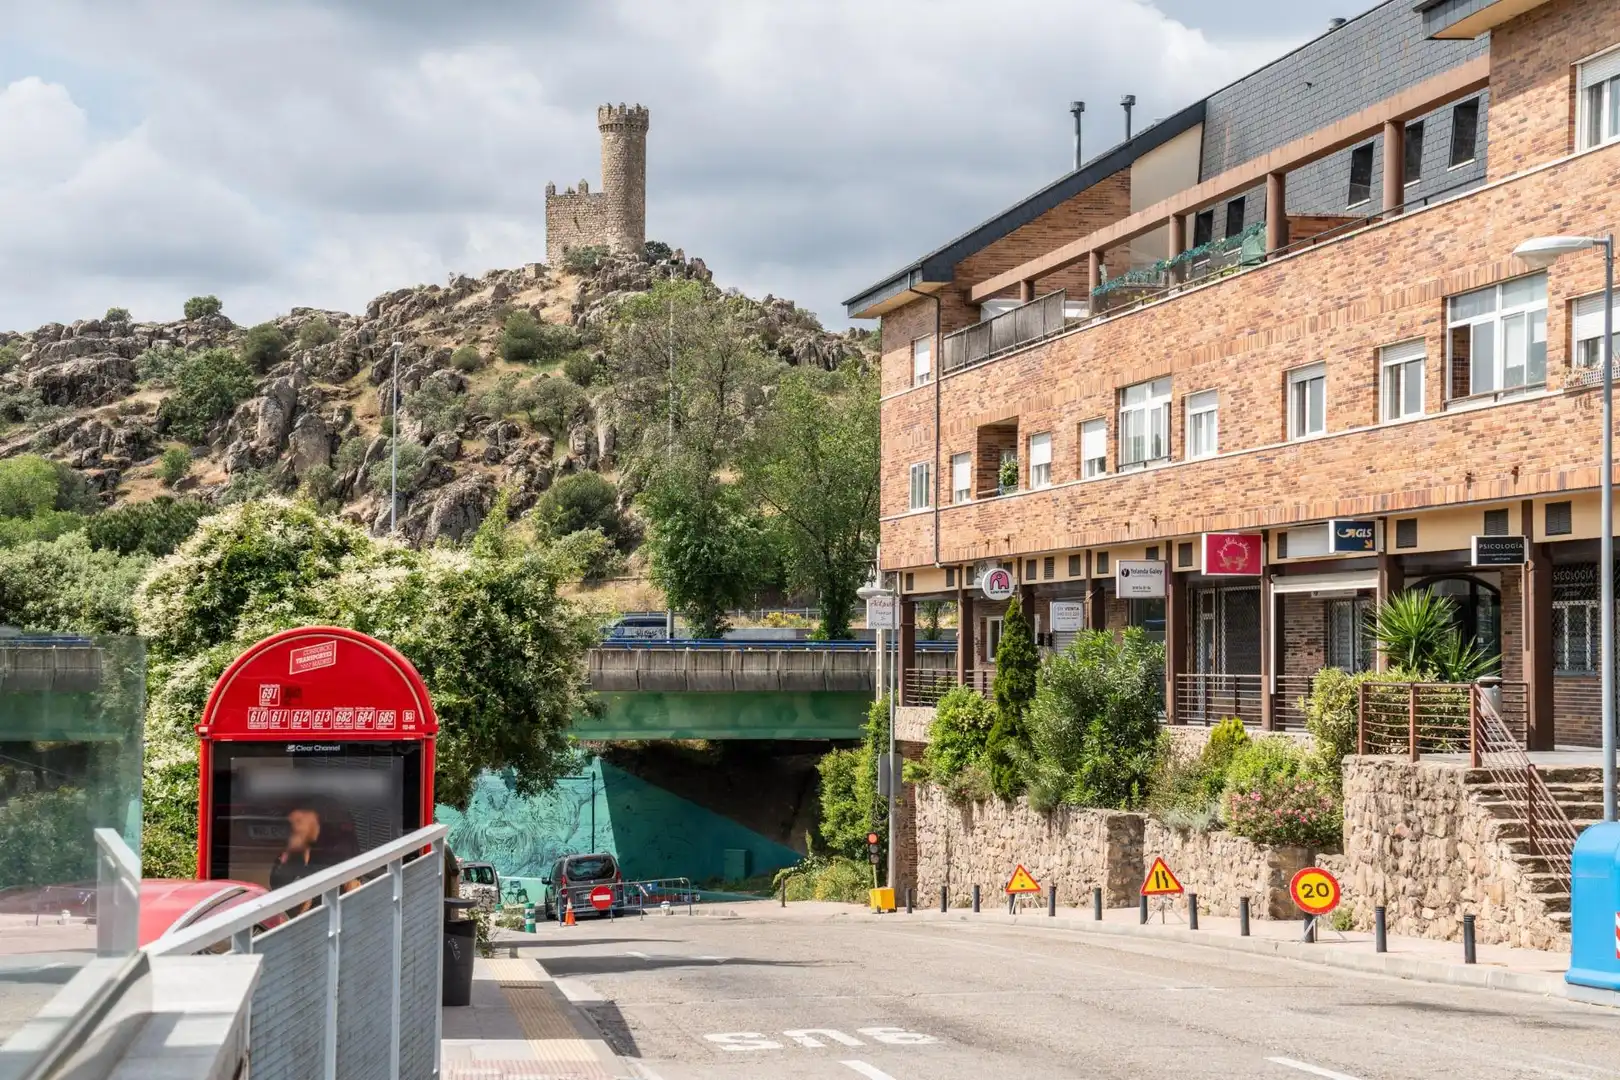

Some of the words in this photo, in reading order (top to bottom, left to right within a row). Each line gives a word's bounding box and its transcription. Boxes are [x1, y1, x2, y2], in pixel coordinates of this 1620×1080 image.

[1355, 528, 1372, 538] GLS
[1130, 567, 1148, 575] Yolanda
[1552, 568, 1595, 581] SICOLOGÍA
[261, 688, 278, 699] 691
[250, 711, 267, 722] 610
[271, 711, 288, 722] 611
[293, 711, 310, 722] 612
[314, 711, 331, 722] 613
[335, 711, 352, 722] 682
[357, 711, 373, 722] 684
[378, 711, 394, 722] 685
[295, 744, 313, 752] Clear
[314, 744, 341, 752] Channel
[1301, 882, 1330, 899] 20
[703, 1026, 940, 1051] BUS
